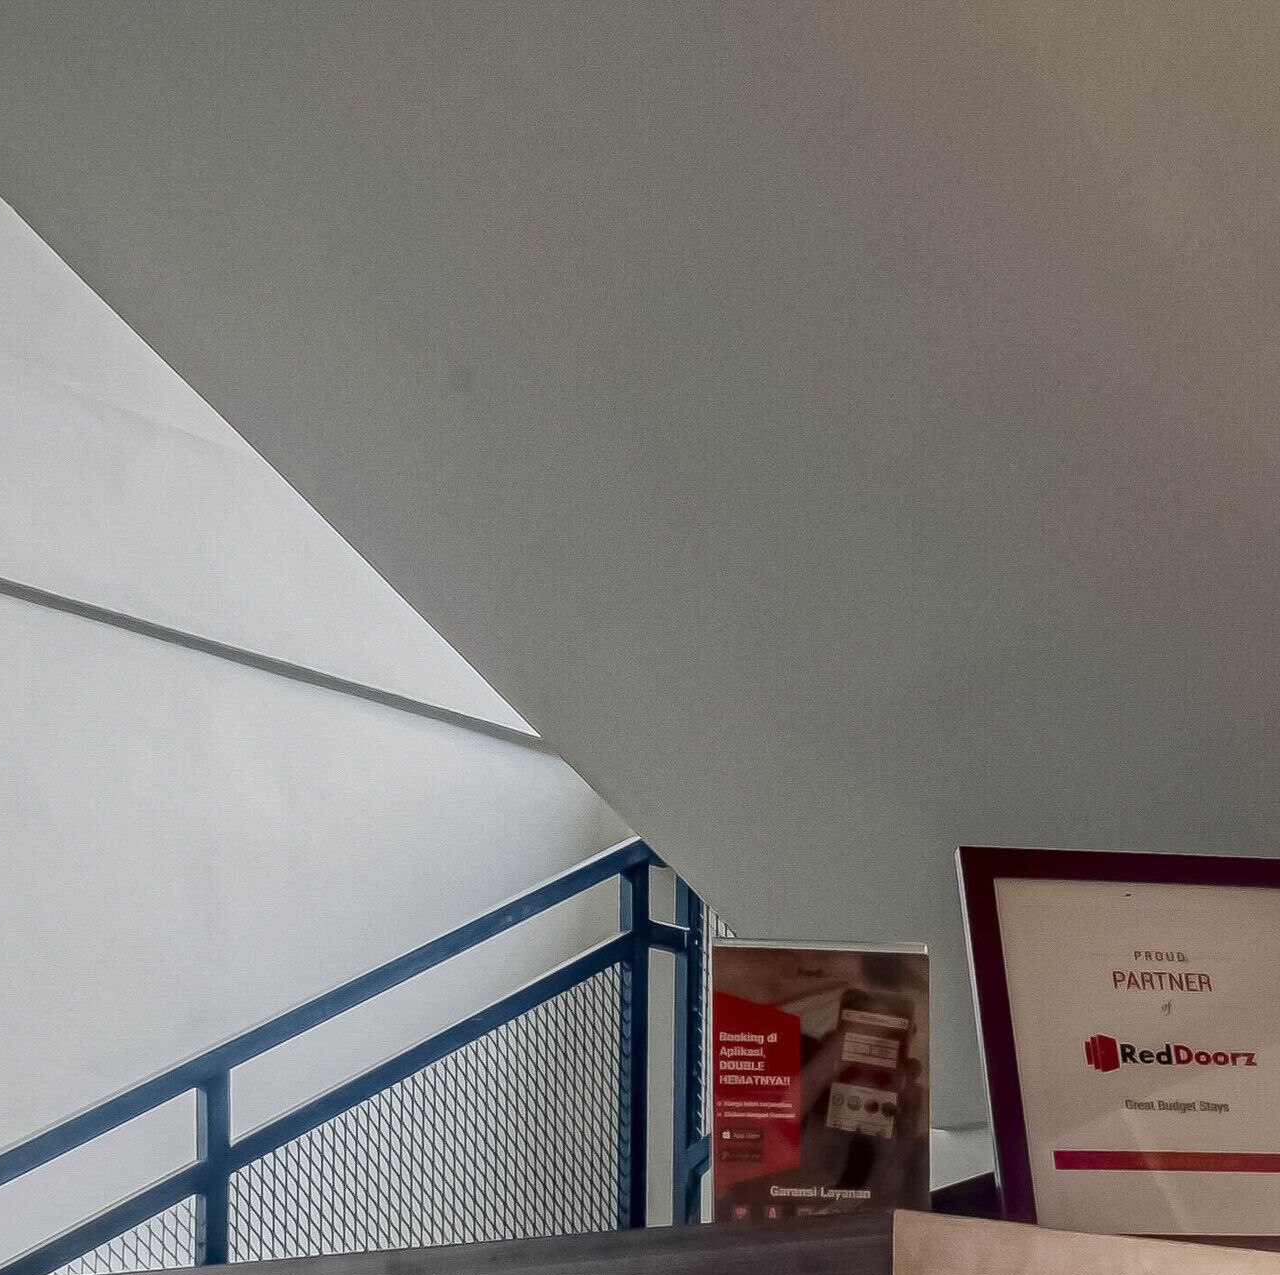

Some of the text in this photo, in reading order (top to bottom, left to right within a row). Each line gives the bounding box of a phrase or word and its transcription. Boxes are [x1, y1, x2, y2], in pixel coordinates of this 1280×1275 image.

[1133, 950, 1186, 963] PROUD
[1112, 970, 1213, 992] PARTNER
[1161, 1000, 1173, 1015] of
[719, 1031, 764, 1045] Booking
[1120, 1042, 1258, 1067] RedDoorz
[719, 1060, 765, 1071] DOUBLE
[1125, 1099, 1230, 1113] Great Budget Stays
[770, 1185, 871, 1200] Garansi Layanan
